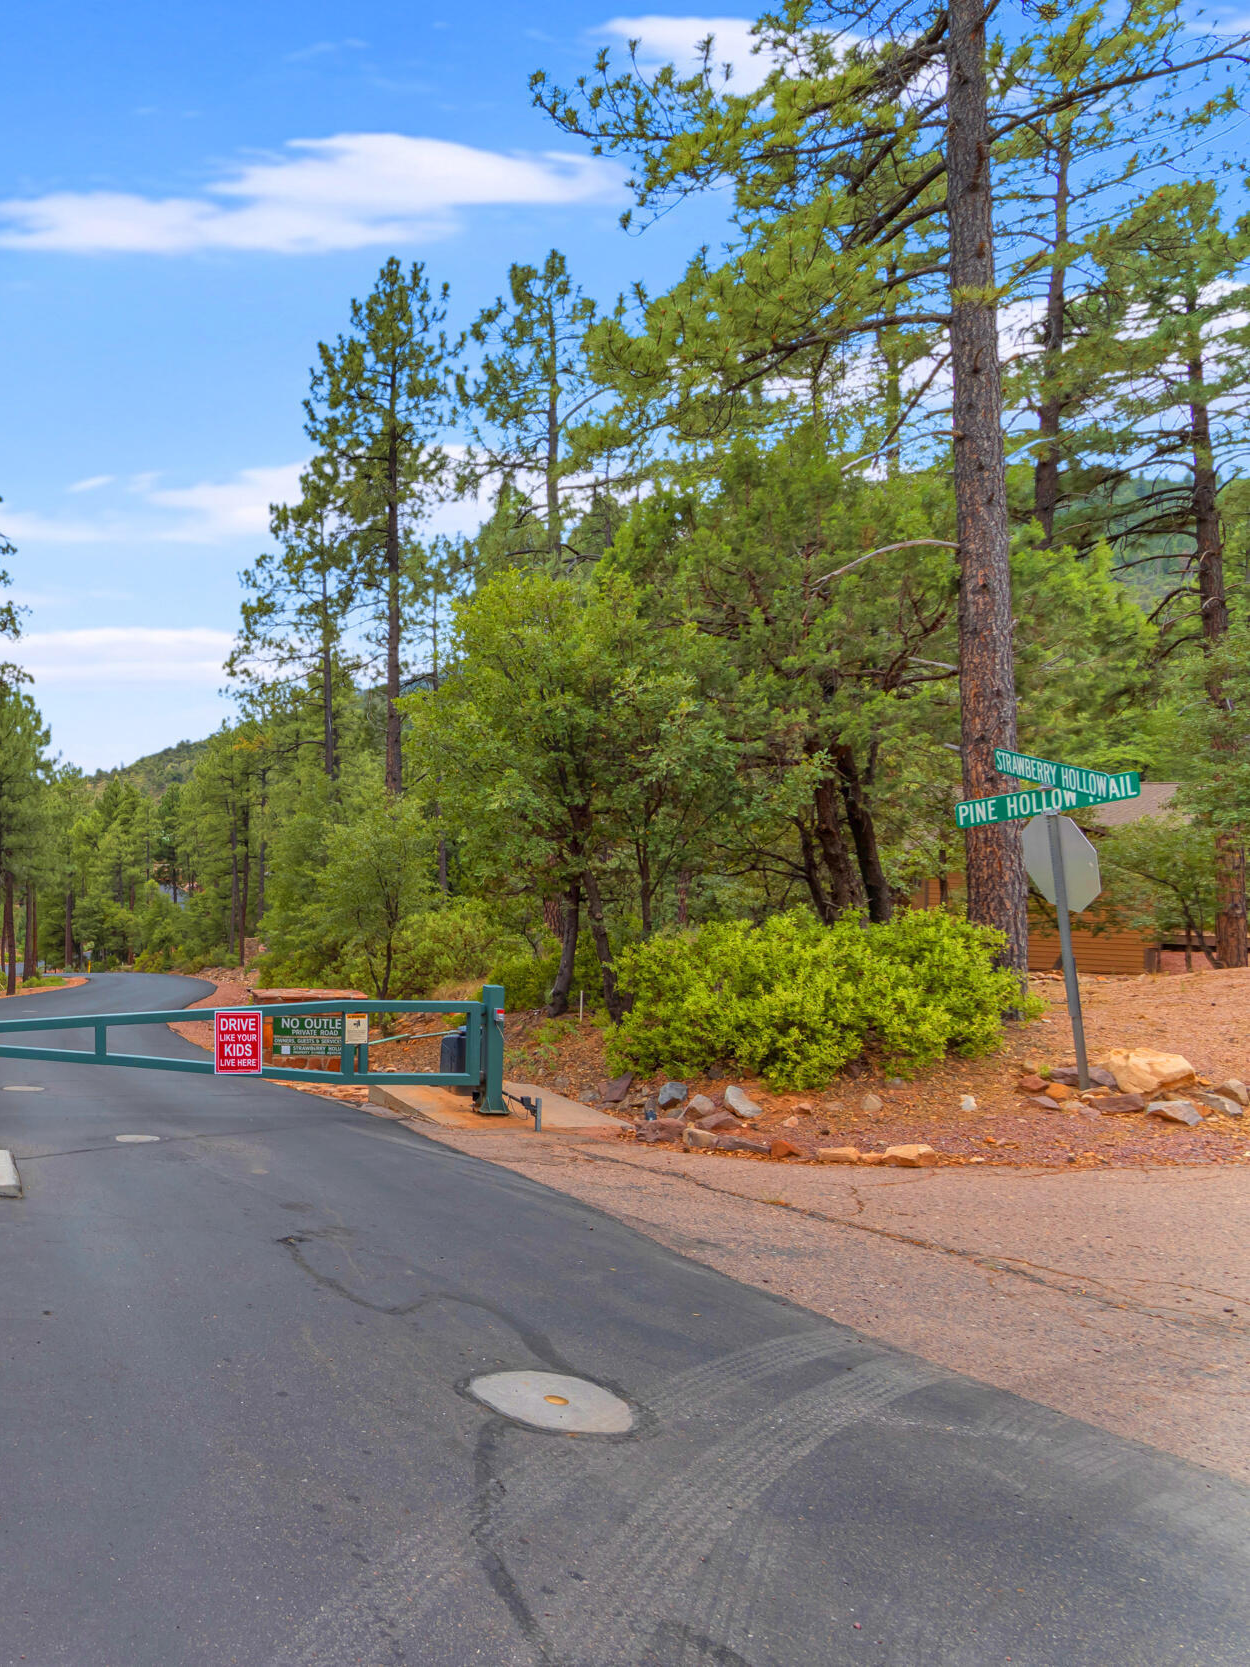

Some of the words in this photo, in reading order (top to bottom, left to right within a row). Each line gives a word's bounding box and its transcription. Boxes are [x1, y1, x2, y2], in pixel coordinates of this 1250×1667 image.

[995, 750, 1058, 785] STRAWBERRY
[1061, 766, 1108, 798] HOLLOW
[958, 799, 998, 826] PINE
[1006, 788, 1077, 818] HOLLOW
[1088, 775, 1138, 803] AIL
[220, 1018, 256, 1031] DRIVE
[281, 1018, 300, 1029] NO
[304, 1018, 342, 1029] OUTLE
[219, 1033, 236, 1042] LIKE
[237, 1033, 257, 1042] YOUR
[224, 1043, 252, 1057] KIDS
[220, 1058, 236, 1067] LIVE
[237, 1058, 257, 1067] HERE
